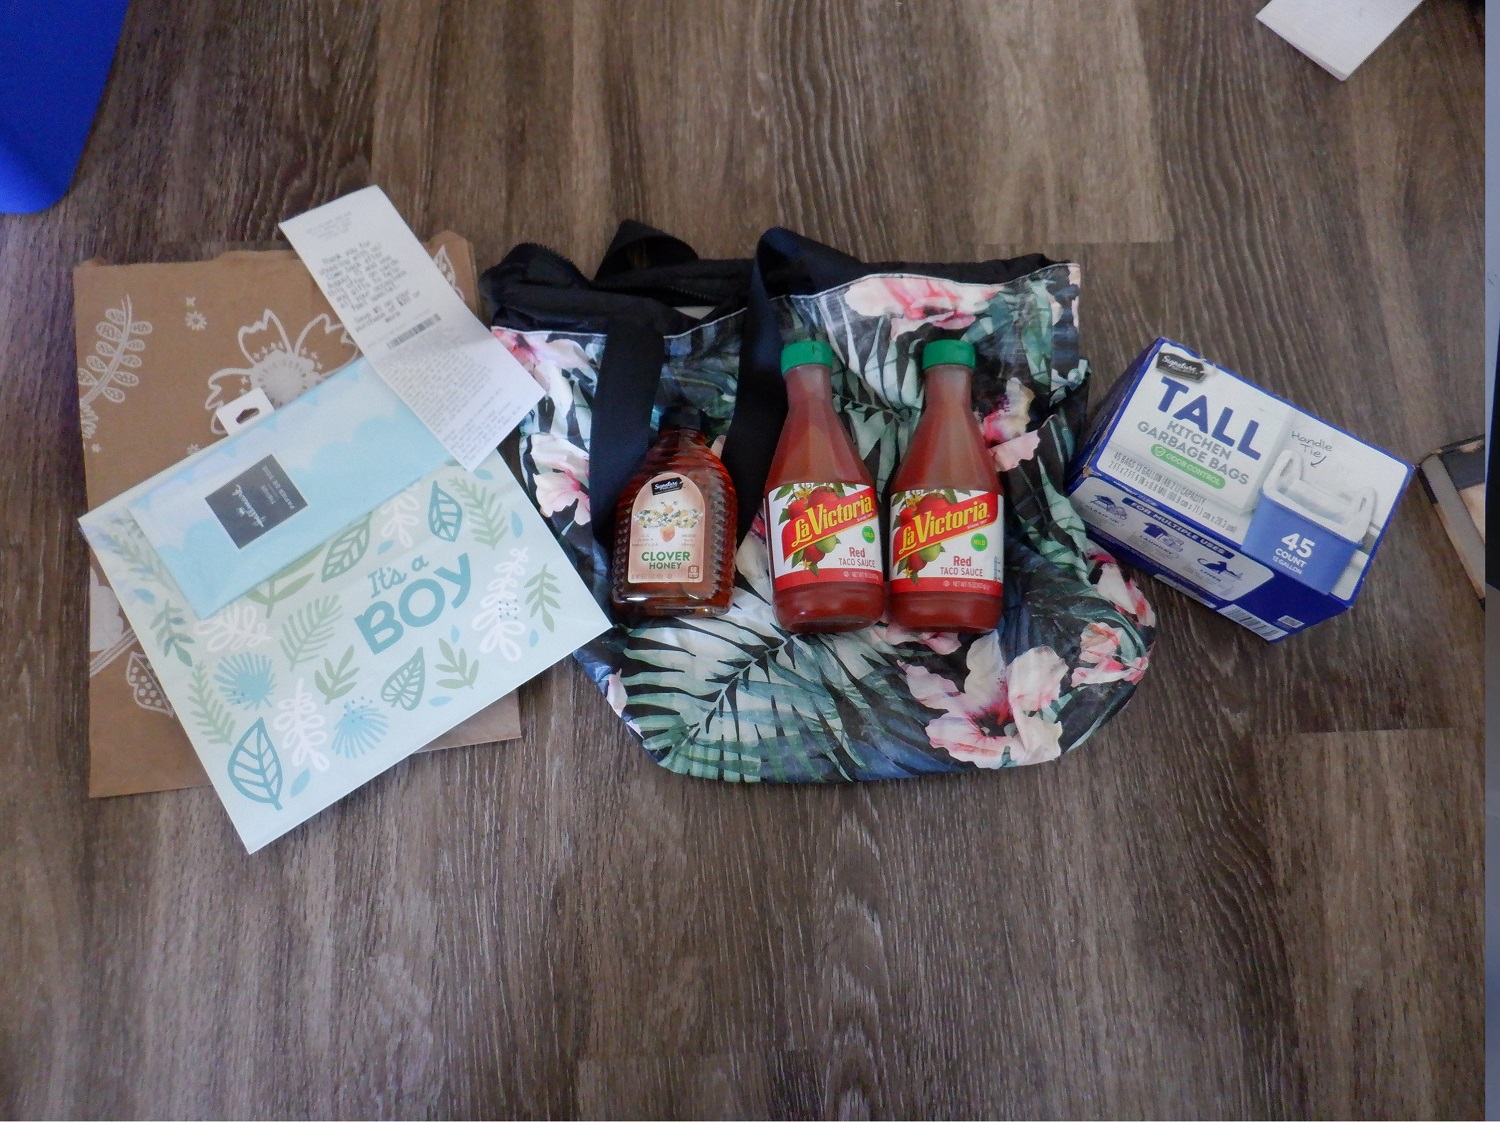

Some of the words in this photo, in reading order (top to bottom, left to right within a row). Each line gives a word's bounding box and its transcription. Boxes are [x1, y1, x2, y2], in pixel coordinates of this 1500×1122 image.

[1157, 377, 1261, 461] TALL
[1137, 420, 1208, 463] GARBAGE
[1208, 457, 1249, 486] BAGS
[1167, 420, 1231, 461] KITCHEN
[1290, 430, 1333, 450] Handle
[791, 519, 812, 547] La
[805, 495, 872, 535] Victoria
[899, 526, 916, 554] La
[912, 501, 988, 543] Victoria
[1130, 501, 1151, 515] FOR
[1152, 512, 1199, 541] MULTIPLE
[1200, 538, 1224, 554] USES
[641, 551, 690, 561] CLOVER
[849, 546, 865, 558] Red
[1275, 547, 1307, 567] COUNT
[1281, 531, 1316, 559] 45
[839, 558, 856, 567] TACO
[857, 559, 876, 568] SAUCE
[940, 567, 959, 576] TACO
[961, 568, 983, 577] SAUCE
[953, 555, 972, 567] Red
[1277, 557, 1303, 575] GALLON
[367, 567, 408, 601] It's
[411, 554, 430, 573] a
[353, 552, 472, 655] BOY
